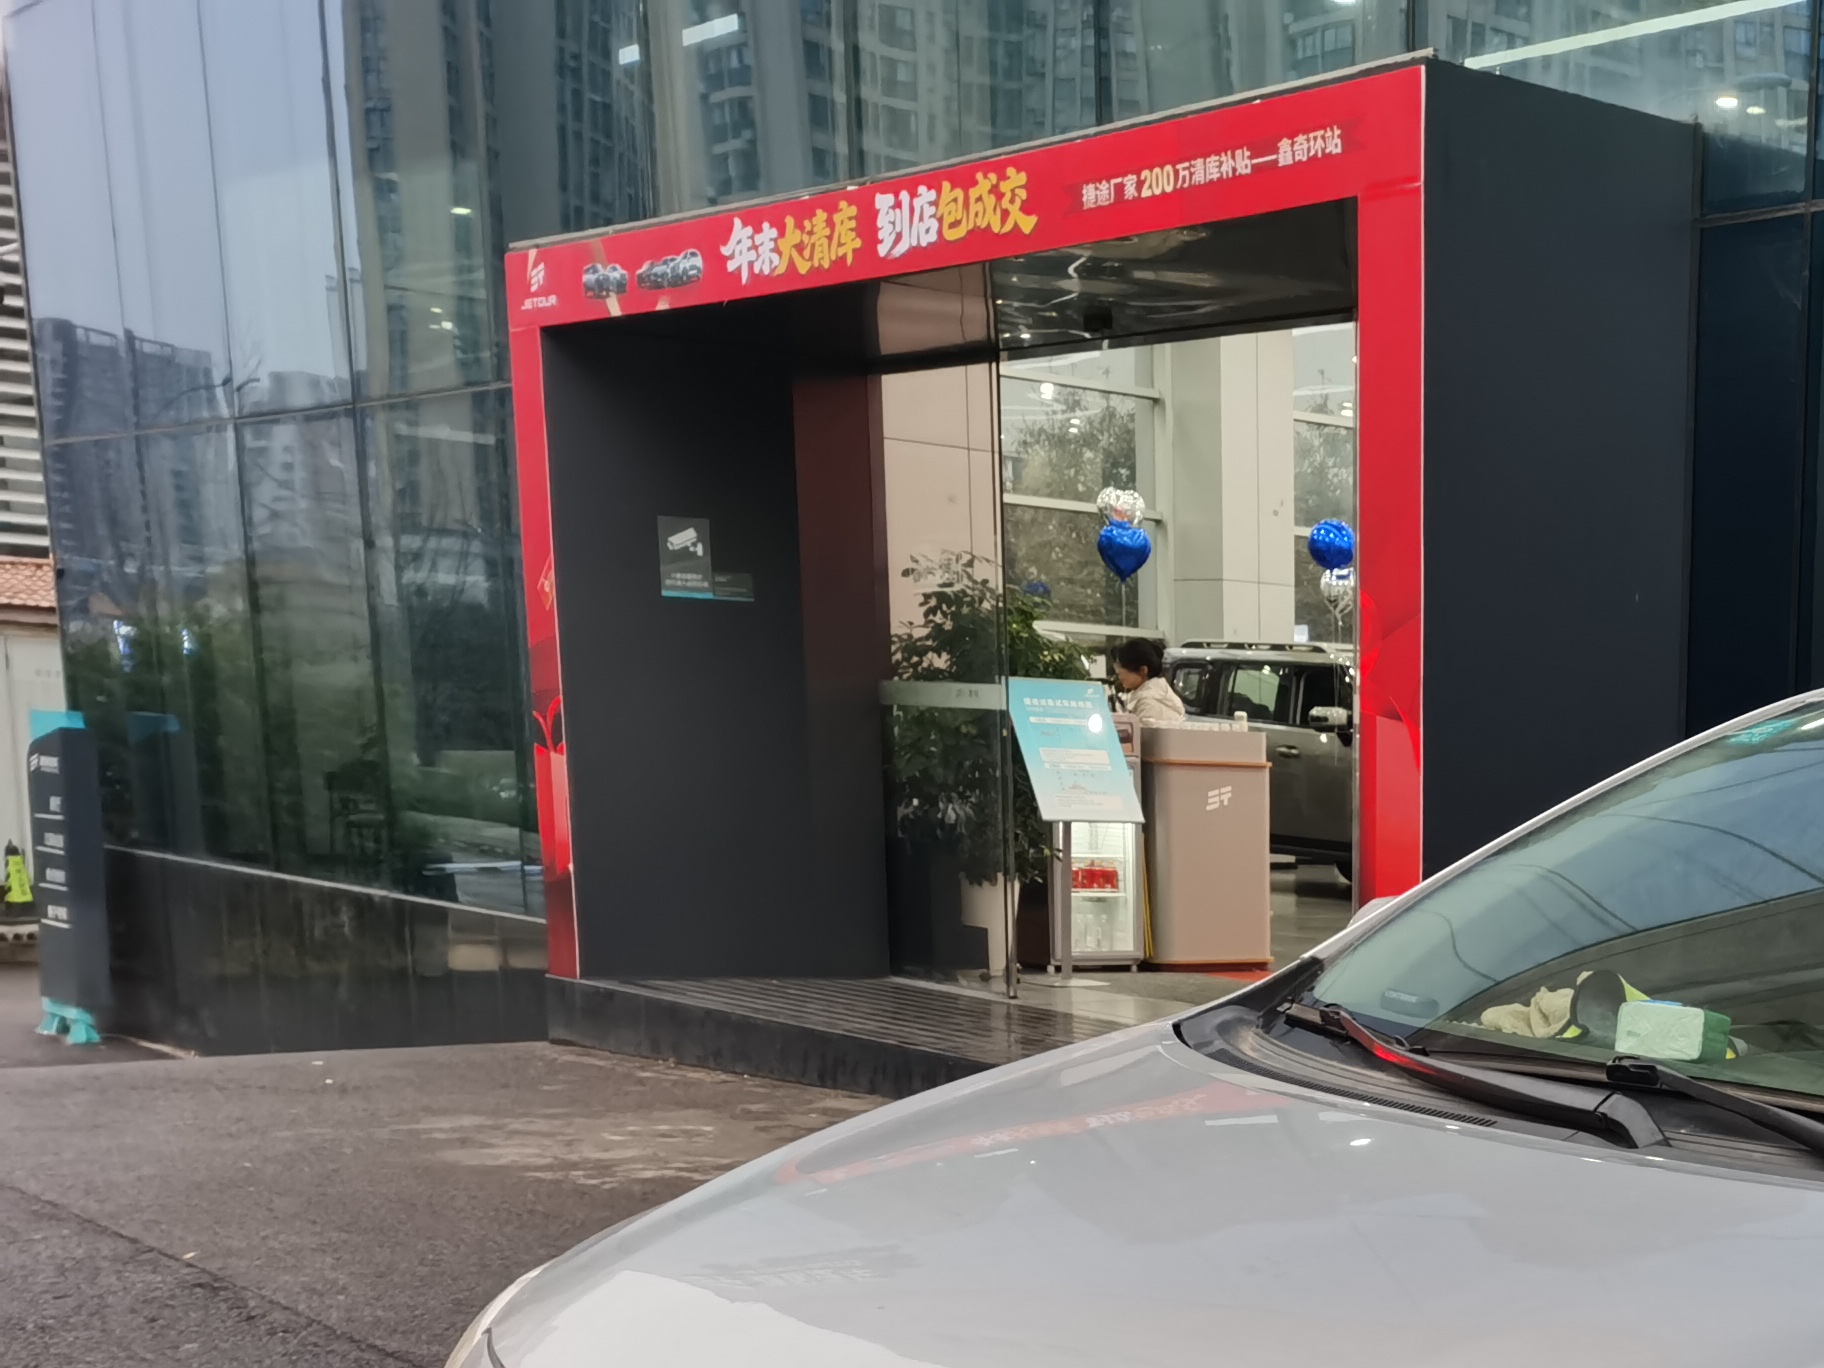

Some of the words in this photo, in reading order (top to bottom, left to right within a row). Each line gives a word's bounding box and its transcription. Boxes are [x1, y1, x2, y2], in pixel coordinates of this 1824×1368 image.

[720, 200, 862, 285] 年末大清库
[874, 166, 1038, 259] 到店包成交
